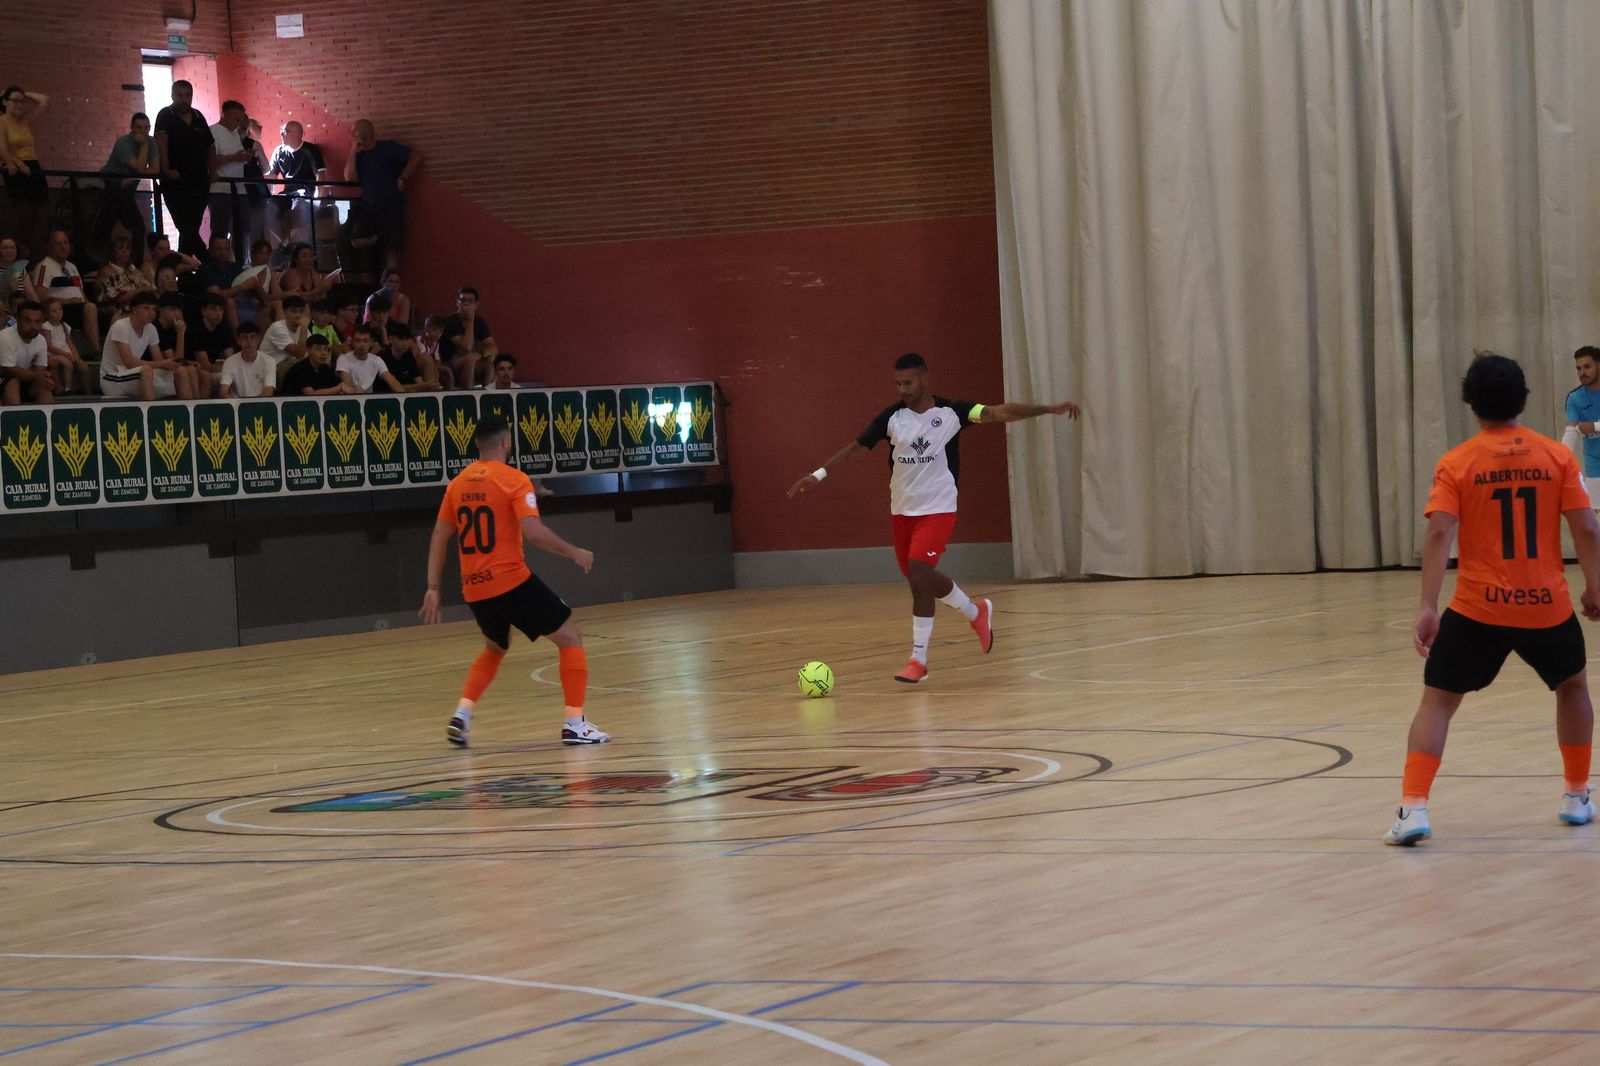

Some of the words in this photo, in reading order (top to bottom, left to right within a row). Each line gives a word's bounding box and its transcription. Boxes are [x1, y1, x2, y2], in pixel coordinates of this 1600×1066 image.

[329, 466, 343, 475] CAJA
[344, 465, 364, 474] RURAL
[369, 464, 384, 472] CAJA
[384, 462, 403, 472] RURAL
[409, 462, 423, 470] CAJA
[424, 461, 442, 470] RURAL
[199, 474, 214, 483] CAJA
[216, 472, 237, 482] RURAL
[244, 472, 259, 480] CAJA
[260, 470, 280, 480] RURAL
[287, 468, 302, 478] CAJA
[302, 468, 323, 477] RURAL
[106, 479, 122, 488] CAJA
[123, 478, 146, 487] RURAL
[153, 476, 169, 485] CAJA
[170, 475, 192, 484] RURAL
[5, 484, 23, 494] CAJA
[24, 483, 48, 493] RURAL
[56, 482, 74, 491] CAJA
[75, 480, 98, 490] RURAL
[461, 493, 487, 502] CHINO
[1490, 486, 1538, 559] 11
[458, 505, 496, 554] 20
[462, 570, 494, 586] vesa
[1485, 586, 1552, 605] uvesa
